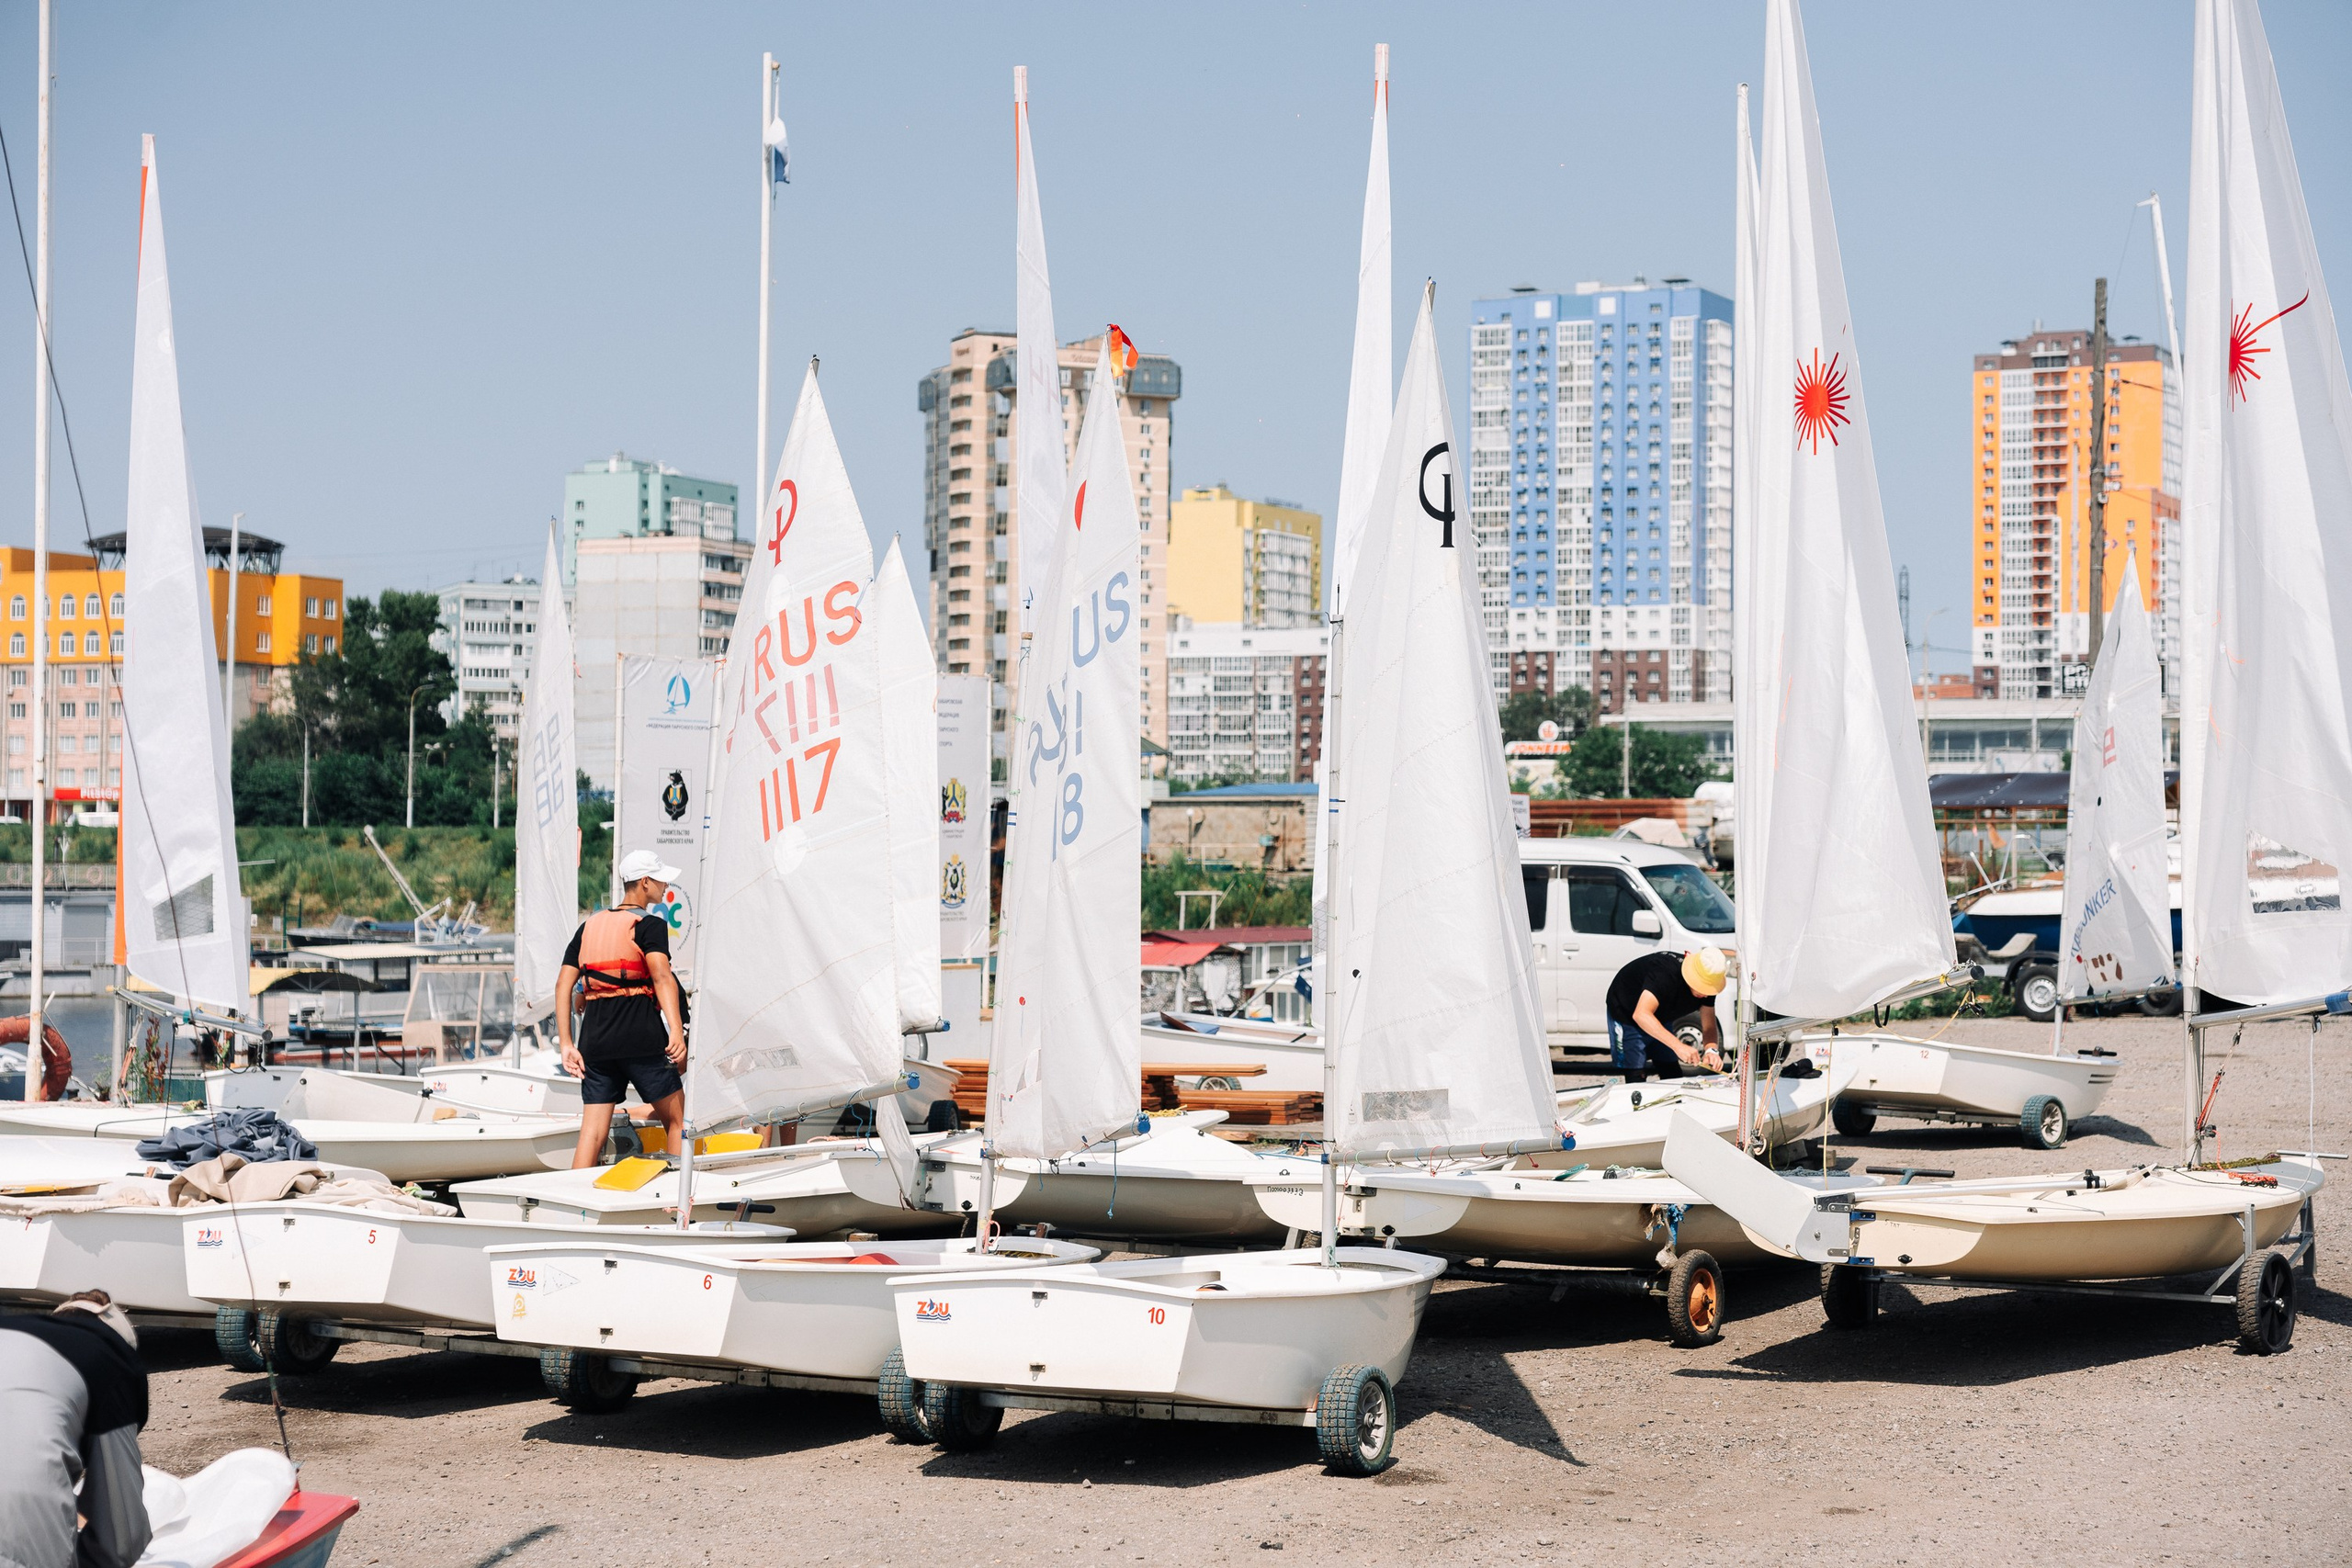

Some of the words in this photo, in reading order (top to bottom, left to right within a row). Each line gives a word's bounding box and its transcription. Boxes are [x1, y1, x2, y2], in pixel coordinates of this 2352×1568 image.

[754, 581, 863, 696] RUS
[760, 737, 841, 843] 1117
[1920, 1050, 1929, 1059] 12
[368, 1229, 377, 1245] 5
[704, 1274, 713, 1290] 6
[1148, 1306, 1165, 1325] 10
